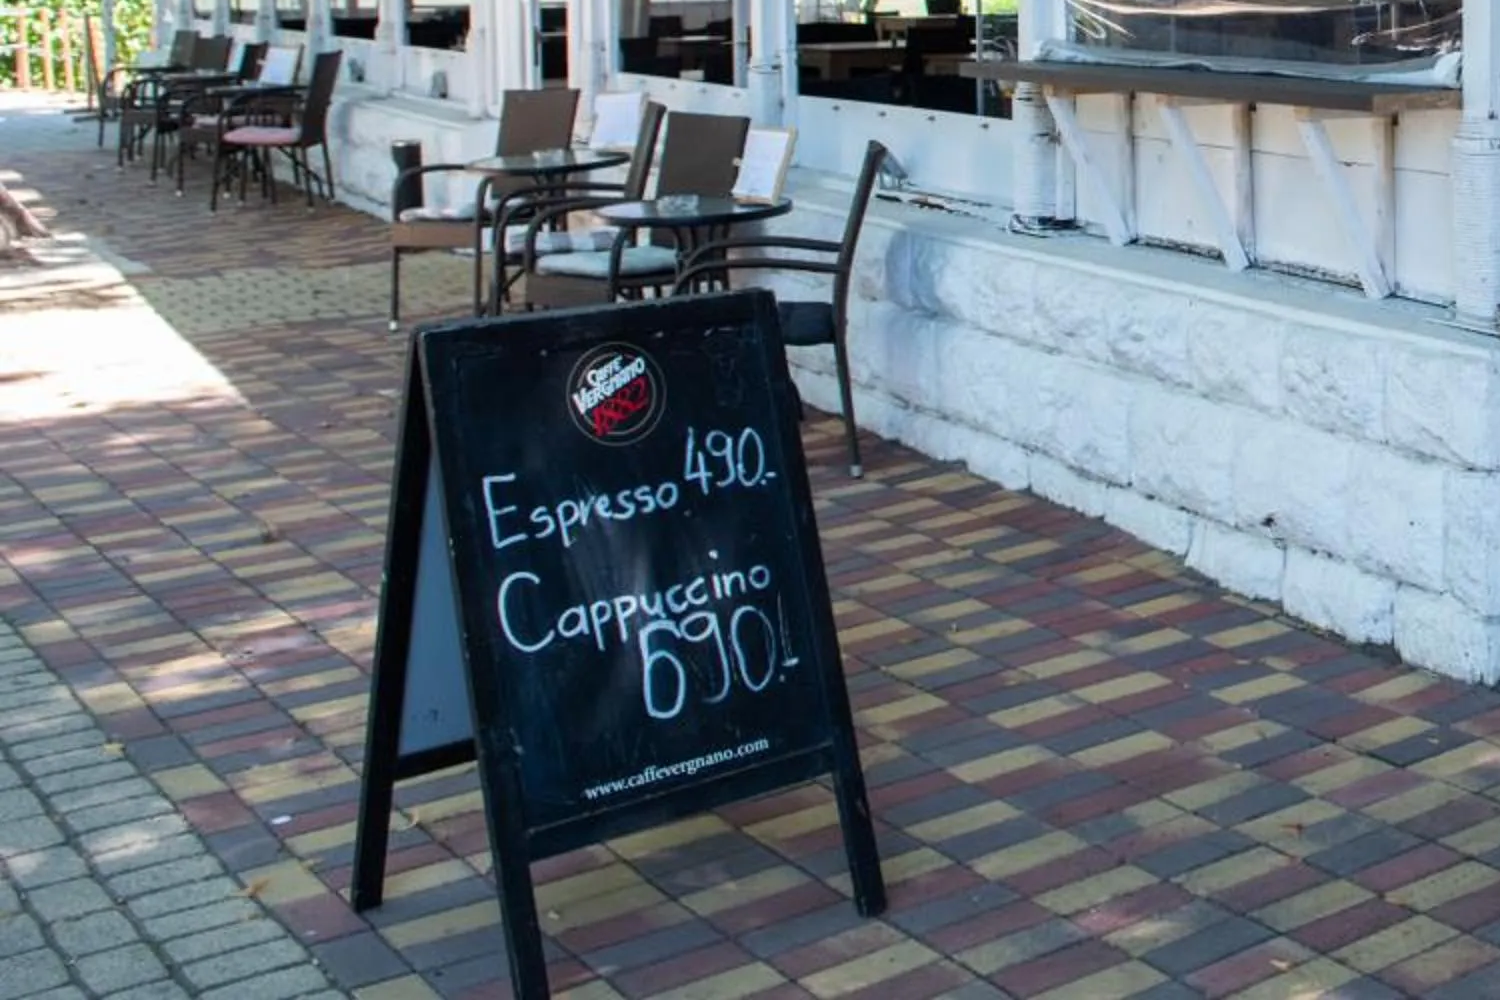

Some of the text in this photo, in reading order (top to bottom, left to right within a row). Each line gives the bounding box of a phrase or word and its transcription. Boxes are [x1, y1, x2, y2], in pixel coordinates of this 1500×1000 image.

[482, 472, 679, 548] Espresso
[497, 550, 770, 653] Cappuccino
[582, 737, 769, 801] www.caffevergnano.com
